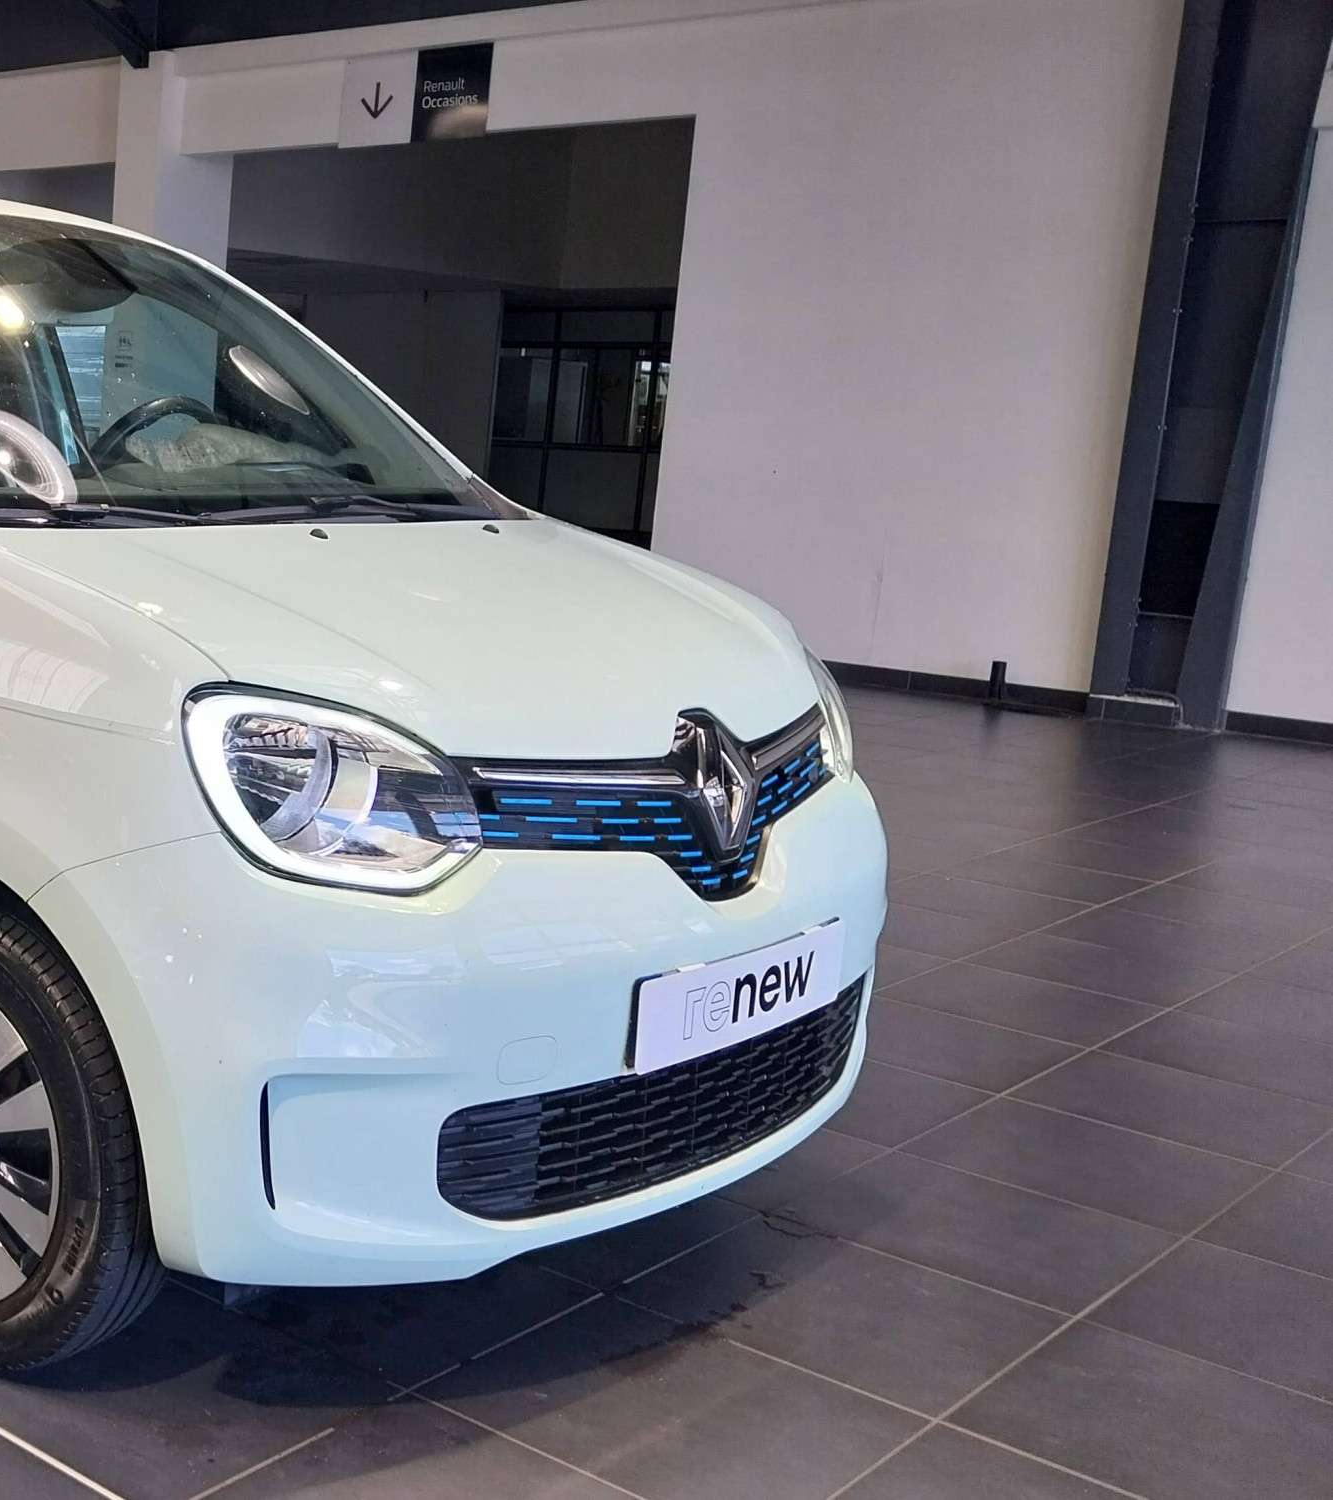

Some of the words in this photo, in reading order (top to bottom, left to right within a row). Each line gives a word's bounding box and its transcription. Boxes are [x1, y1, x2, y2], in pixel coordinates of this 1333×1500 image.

[423, 77, 465, 93] Renault
[422, 93, 478, 109] Occasions
[683, 950, 815, 1041] renew
